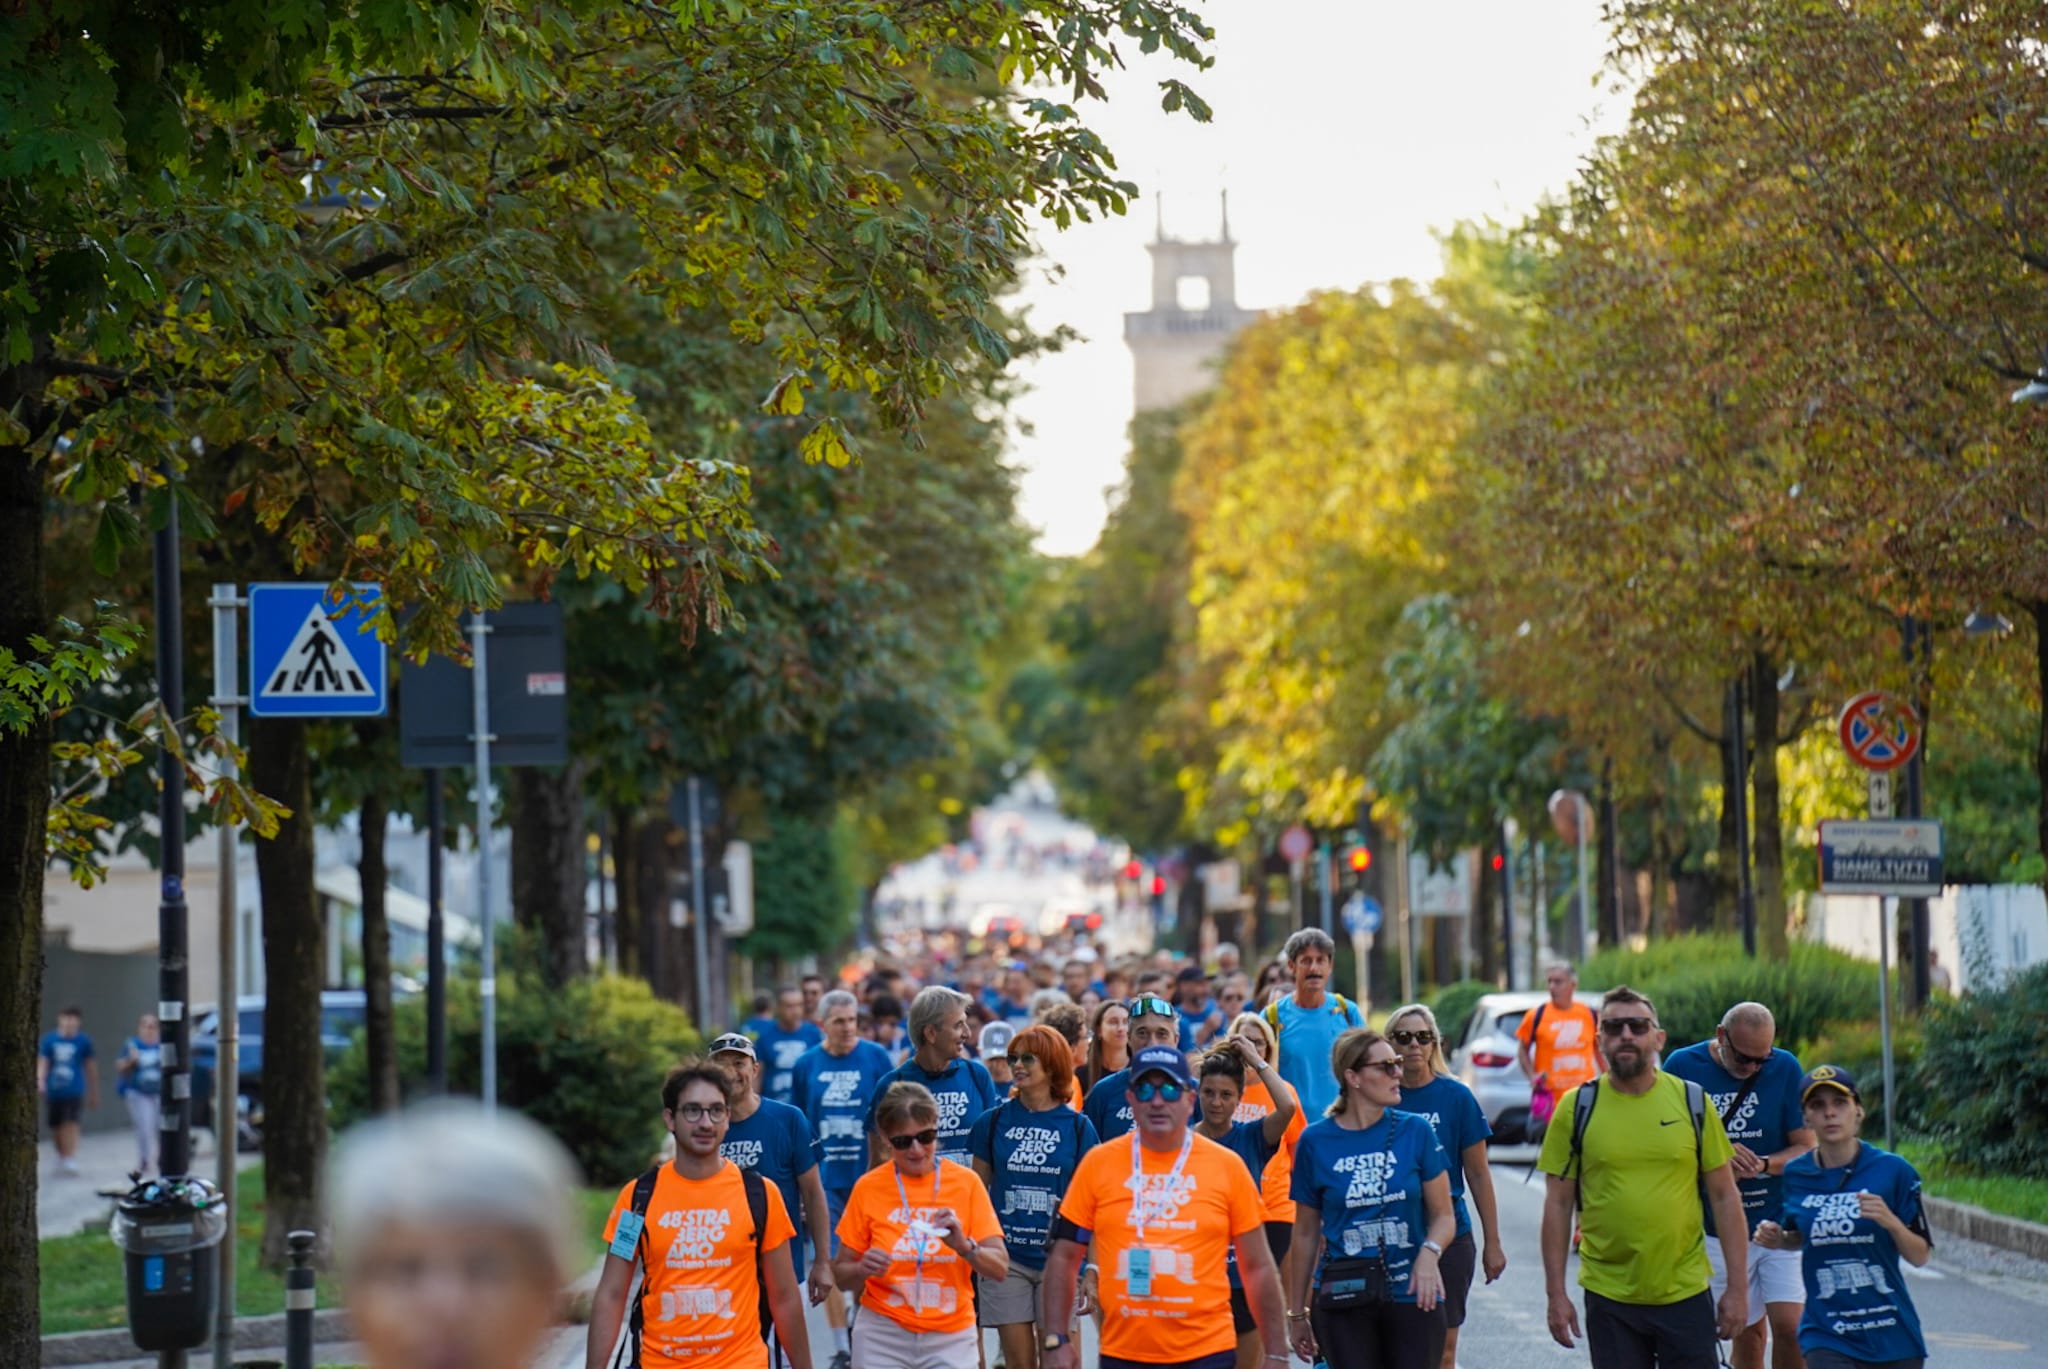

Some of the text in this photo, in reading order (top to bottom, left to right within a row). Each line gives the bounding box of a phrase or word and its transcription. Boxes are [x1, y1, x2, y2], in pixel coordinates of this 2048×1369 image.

[937, 1103, 967, 1117] ERG
[729, 1153, 759, 1167] ERG
[1008, 1150, 1047, 1165] AMO
[1040, 1166, 1061, 1175] nord
[1810, 1219, 1855, 1238] AMO
[666, 1242, 714, 1260] AMO
